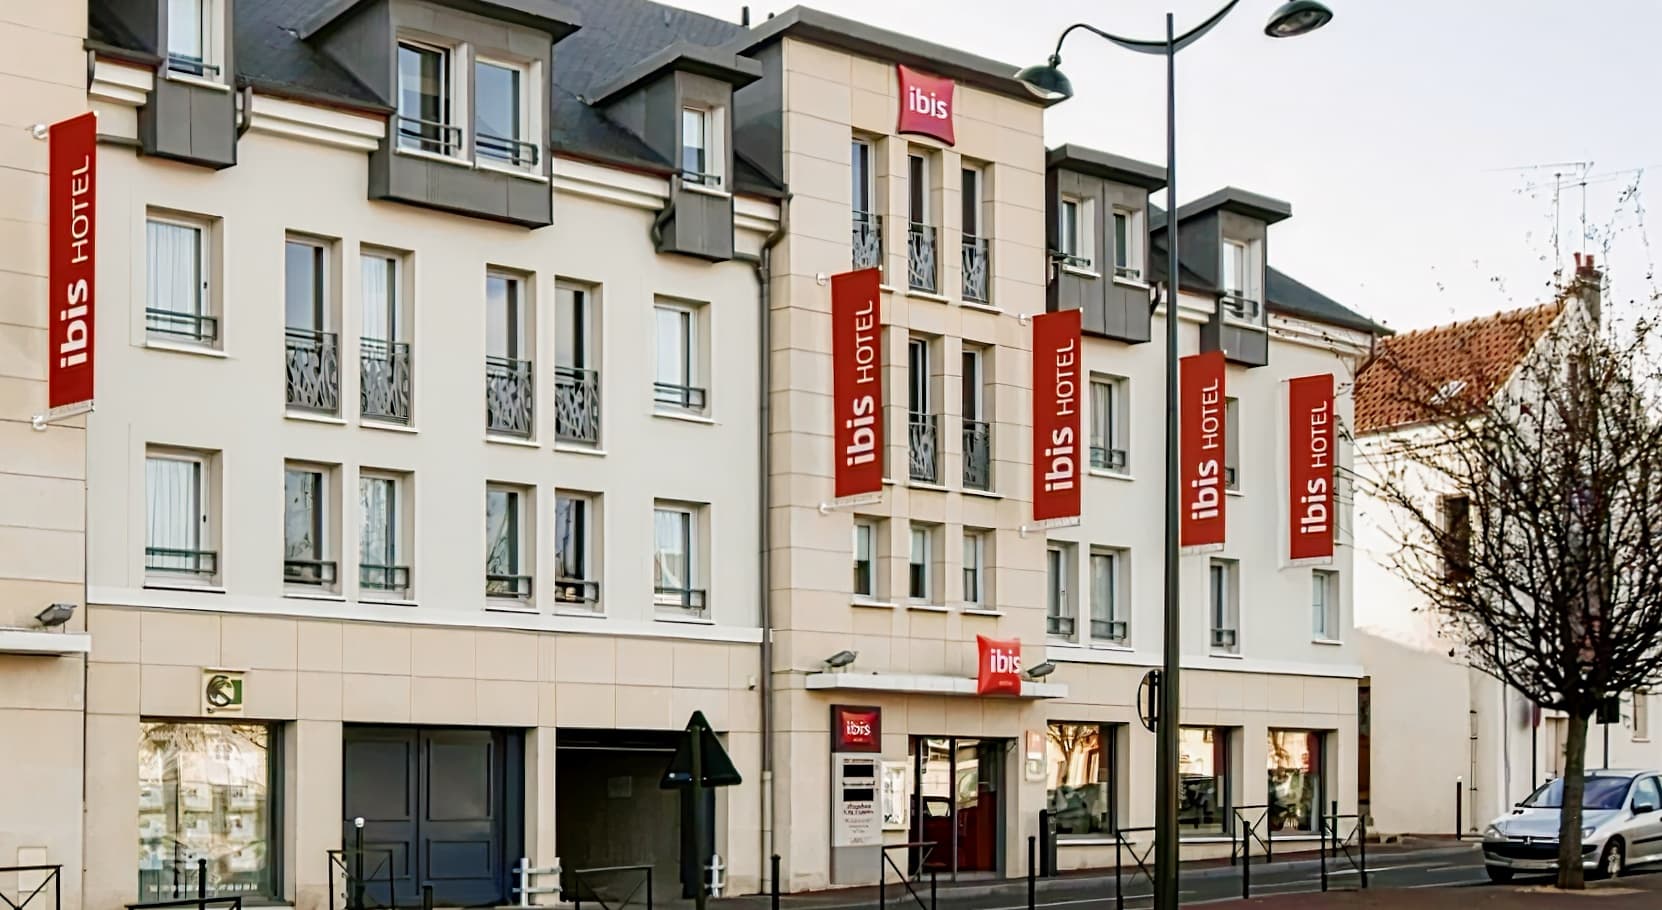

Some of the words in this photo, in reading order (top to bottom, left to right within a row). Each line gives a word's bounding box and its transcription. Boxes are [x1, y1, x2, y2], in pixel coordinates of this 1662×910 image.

[909, 85, 948, 119] ibis
[71, 154, 89, 264] HOTEL
[60, 279, 88, 369] ibis
[856, 300, 874, 384] HOTEL
[1056, 338, 1074, 416] HOTEL
[846, 395, 875, 466] ibis
[1202, 378, 1218, 450] HOTEL
[1311, 400, 1327, 468] HOTEL
[1045, 426, 1074, 492] ibis
[1191, 459, 1219, 520] ibis
[1300, 477, 1327, 534] ibis
[990, 648, 1021, 674] ibis
